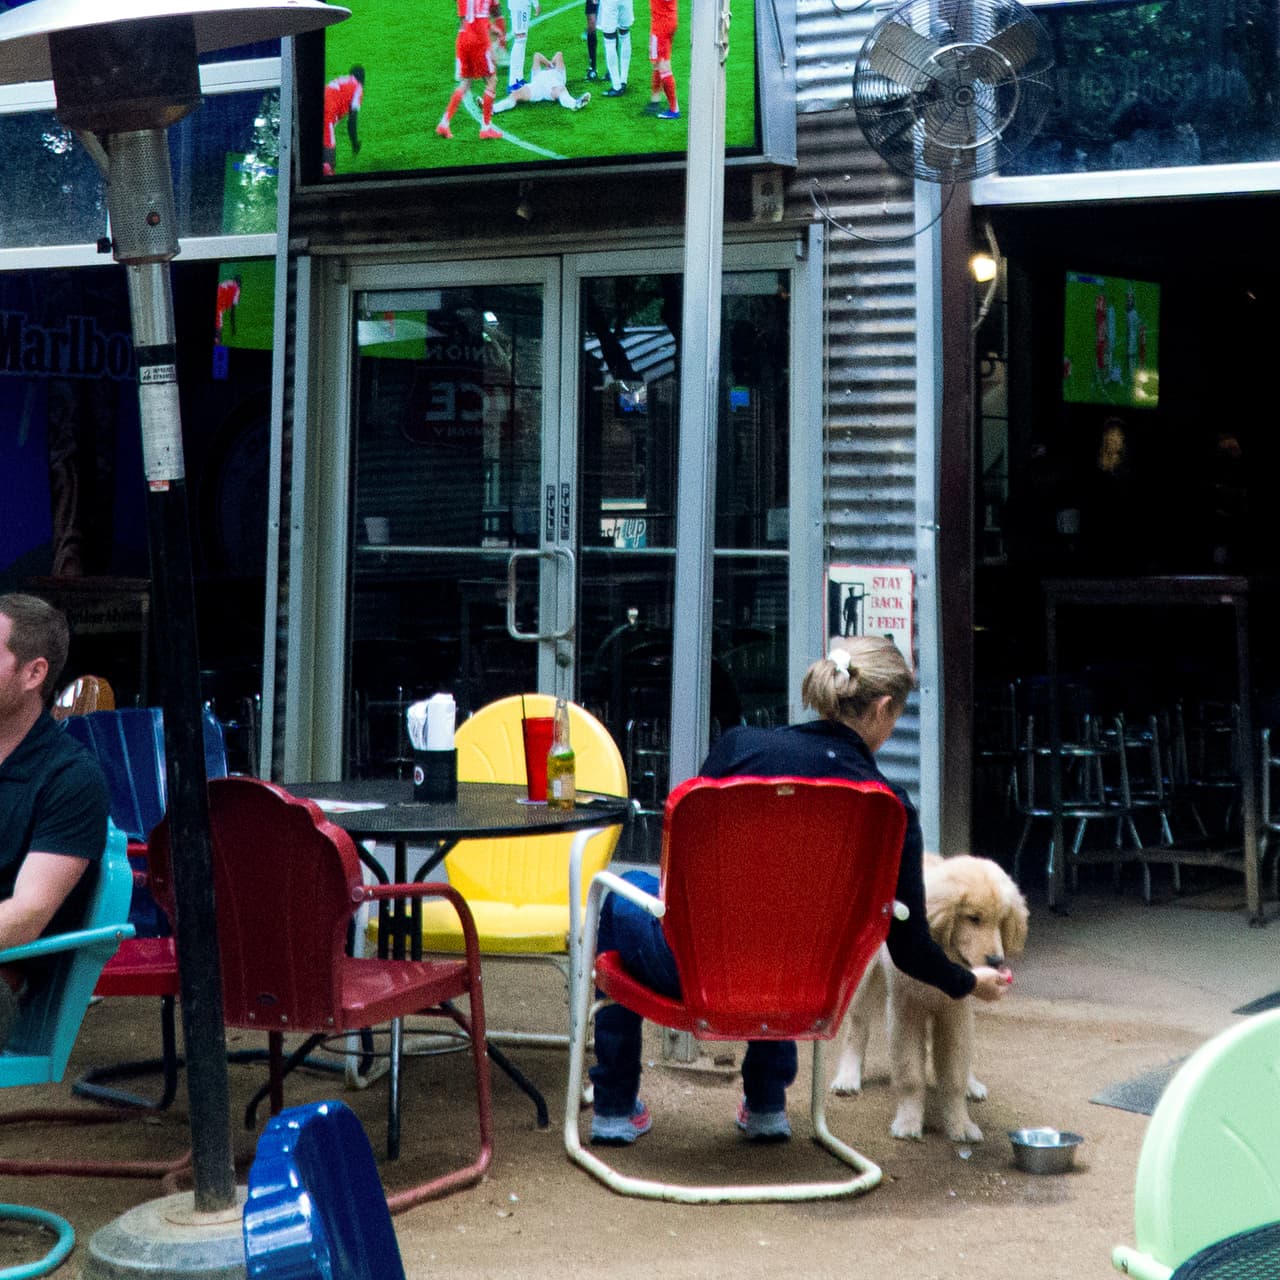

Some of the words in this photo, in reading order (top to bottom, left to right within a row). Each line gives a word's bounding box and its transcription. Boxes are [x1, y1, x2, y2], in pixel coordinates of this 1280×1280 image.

[547, 488, 555, 530] PULL
[872, 577, 903, 589] STAY
[871, 596, 904, 609] BACK
[868, 616, 874, 628] 7
[877, 616, 906, 629] FEET
